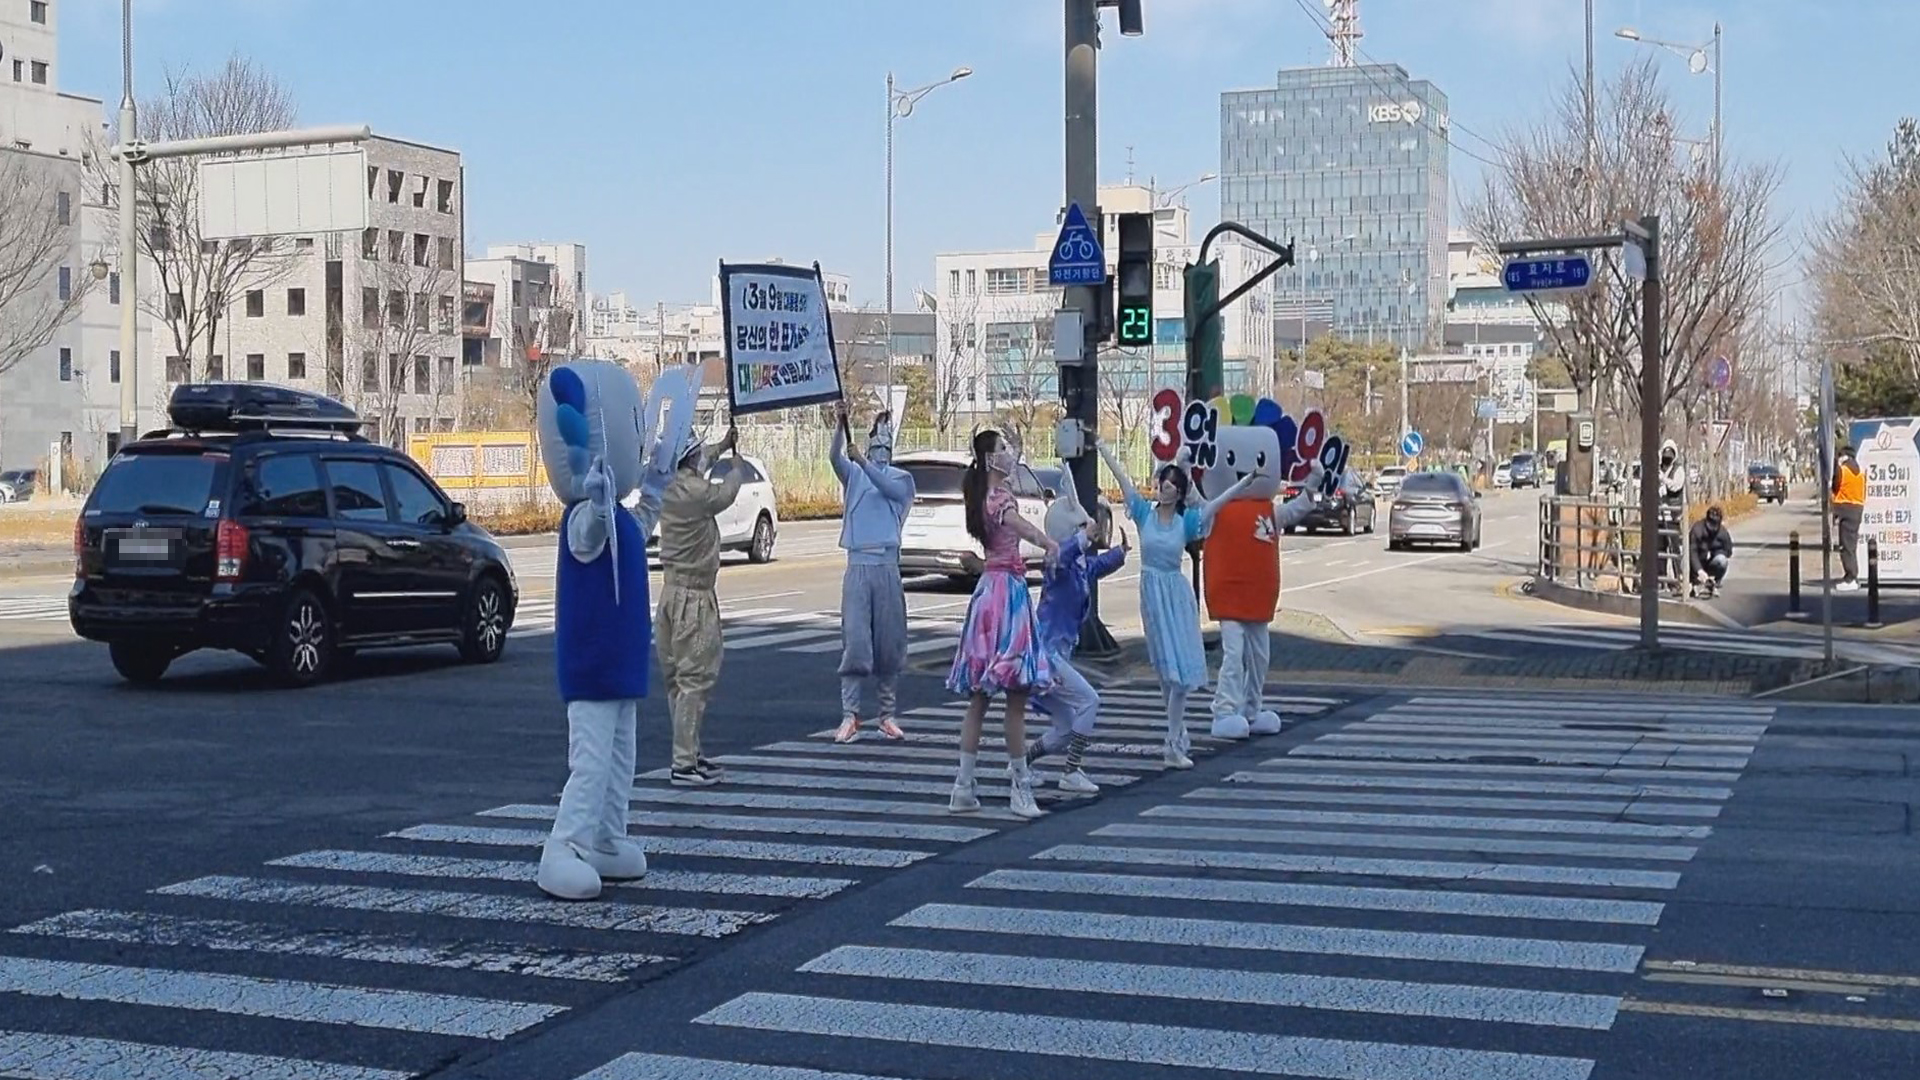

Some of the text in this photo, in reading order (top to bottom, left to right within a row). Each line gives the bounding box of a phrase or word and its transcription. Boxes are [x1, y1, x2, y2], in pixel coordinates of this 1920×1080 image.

[1368, 104, 1401, 123] KBS
[1053, 266, 1100, 280] 자전거횡단
[1122, 308, 1149, 338] 23
[737, 325, 767, 351] 당신의
[769, 321, 780, 352] 한
[1885, 510, 1893, 524] 한
[1895, 510, 1912, 524] 표가
